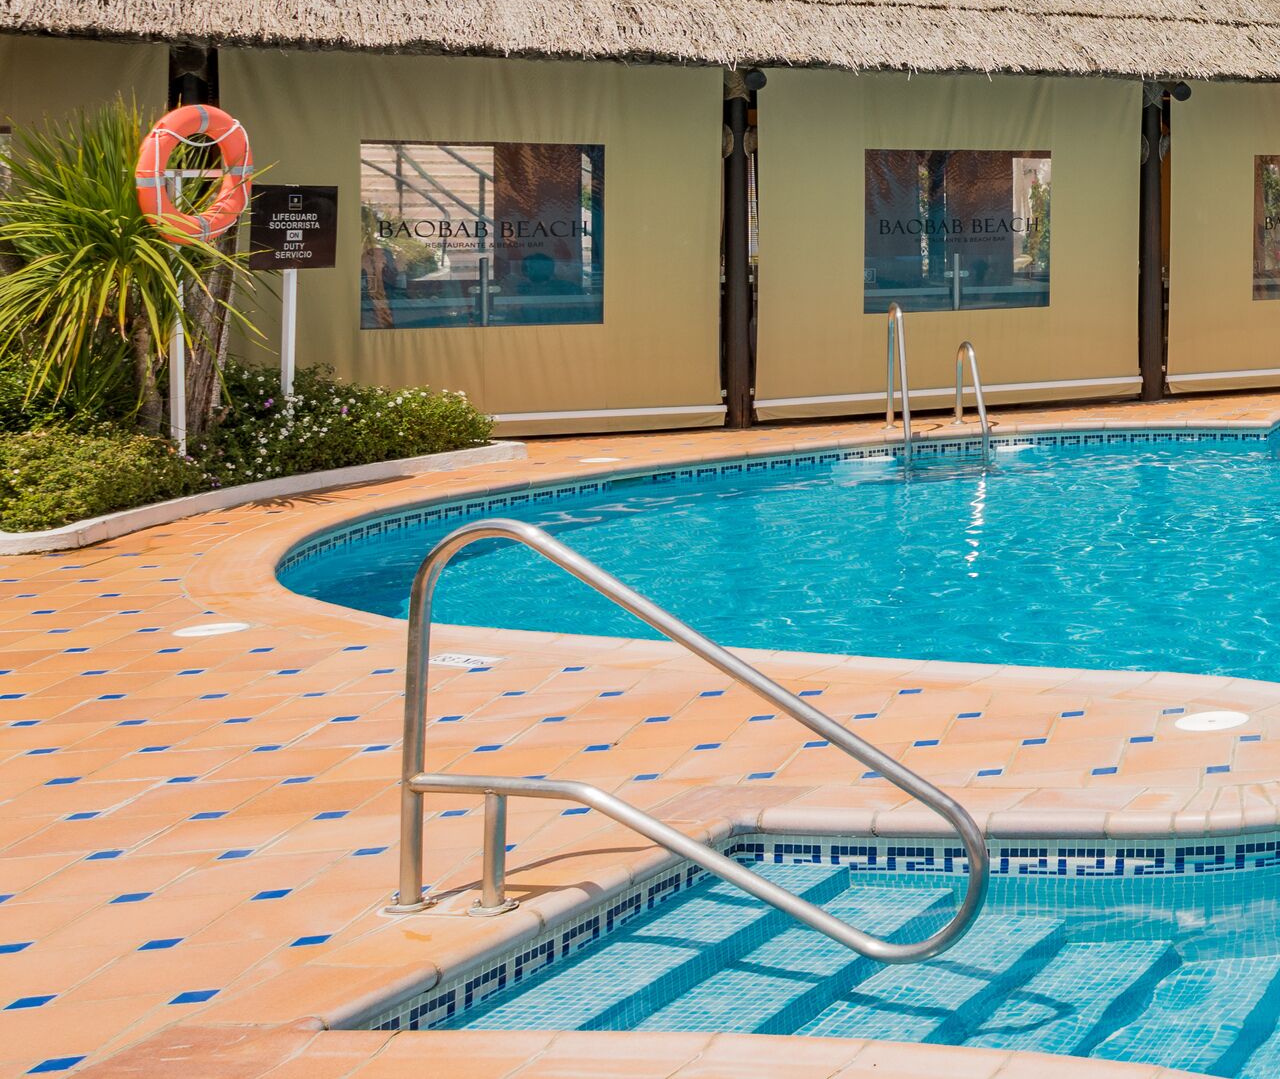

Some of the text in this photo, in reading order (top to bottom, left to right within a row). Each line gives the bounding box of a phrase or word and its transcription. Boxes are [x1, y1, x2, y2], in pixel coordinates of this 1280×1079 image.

[272, 213, 318, 221] LIFEGUARD
[269, 221, 320, 229] SOCORRISTA
[878, 217, 1039, 235] BAOBAB BEACH
[378, 220, 588, 239] BAOBAB BEACH
[283, 242, 305, 250] DUTY
[275, 251, 312, 259] SERVICIO
